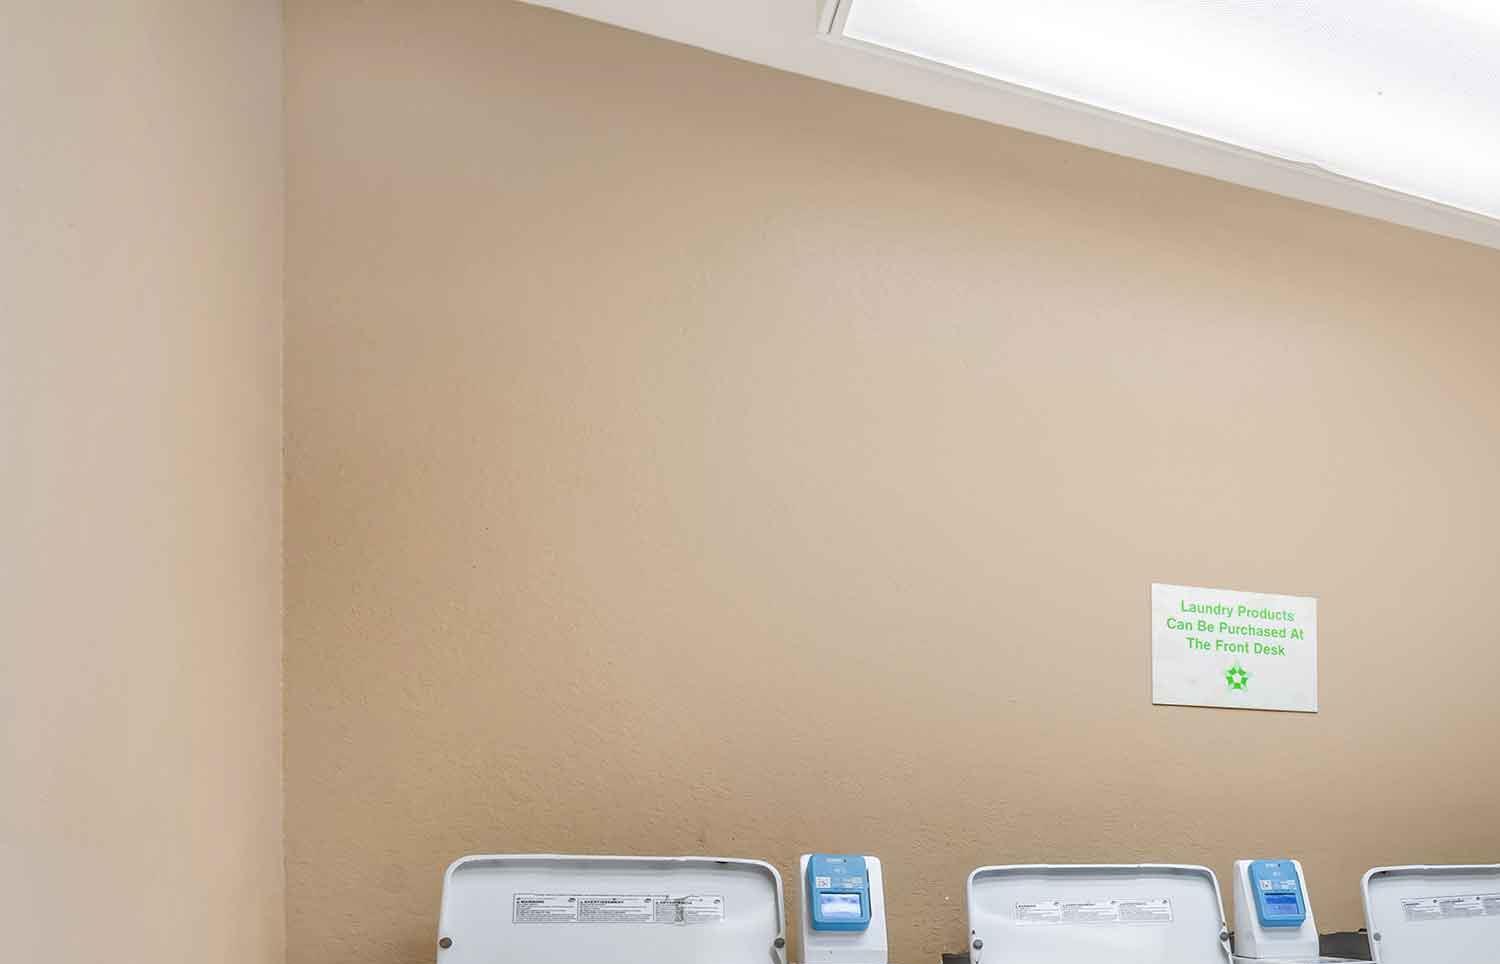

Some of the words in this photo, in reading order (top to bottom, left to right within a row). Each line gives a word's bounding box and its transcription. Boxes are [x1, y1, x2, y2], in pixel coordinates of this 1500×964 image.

[1180, 600, 1234, 618] Laundry
[1237, 605, 1296, 622] Products
[1166, 618, 1193, 631] Can
[1197, 620, 1215, 633] Be
[1219, 622, 1286, 638] Purchased
[1290, 628, 1304, 640] At
[1186, 637, 1211, 650] The
[1215, 640, 1249, 654] Front
[1254, 642, 1286, 656] Desk
